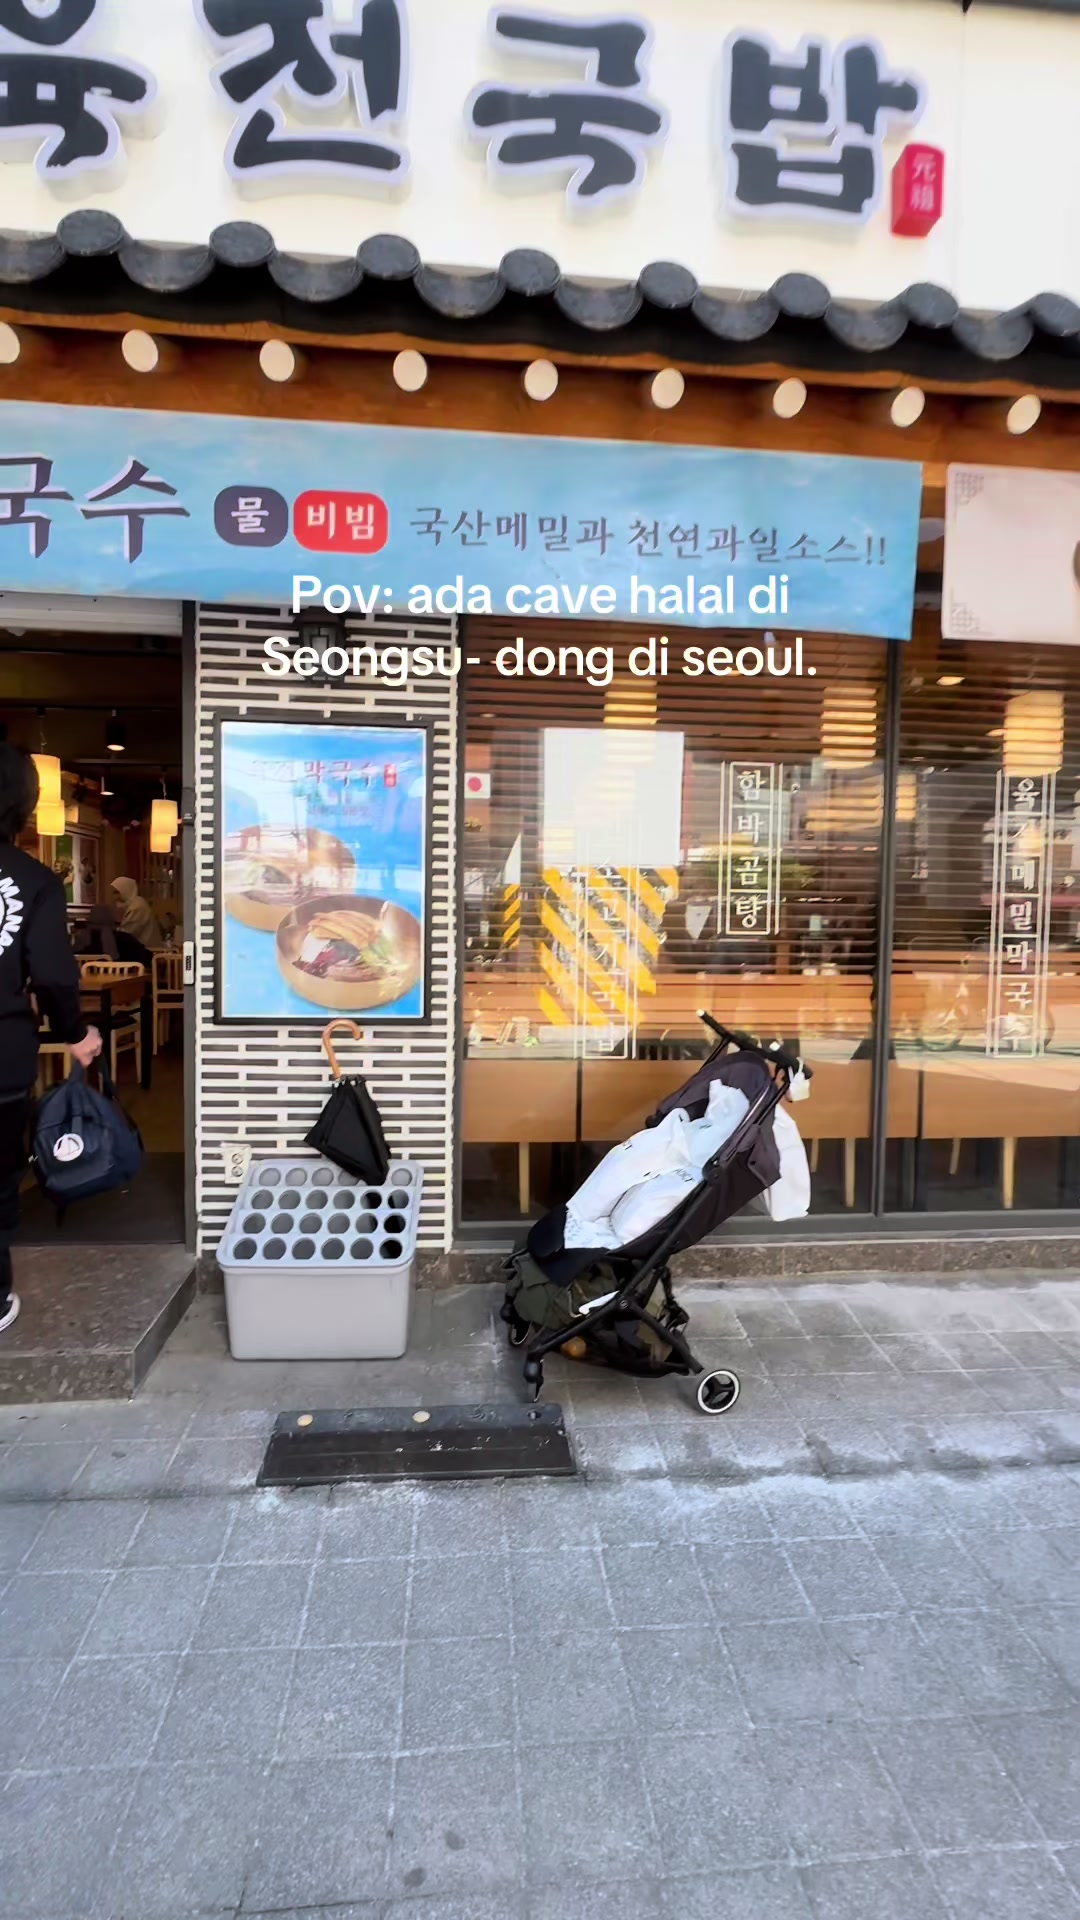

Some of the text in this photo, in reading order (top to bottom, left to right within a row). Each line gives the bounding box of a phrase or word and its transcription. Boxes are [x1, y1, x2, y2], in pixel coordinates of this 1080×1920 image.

[230, 494, 270, 535] 물
[305, 501, 376, 542] 비빔
[410, 505, 887, 567] 국산메밀과 천연과일소스!!
